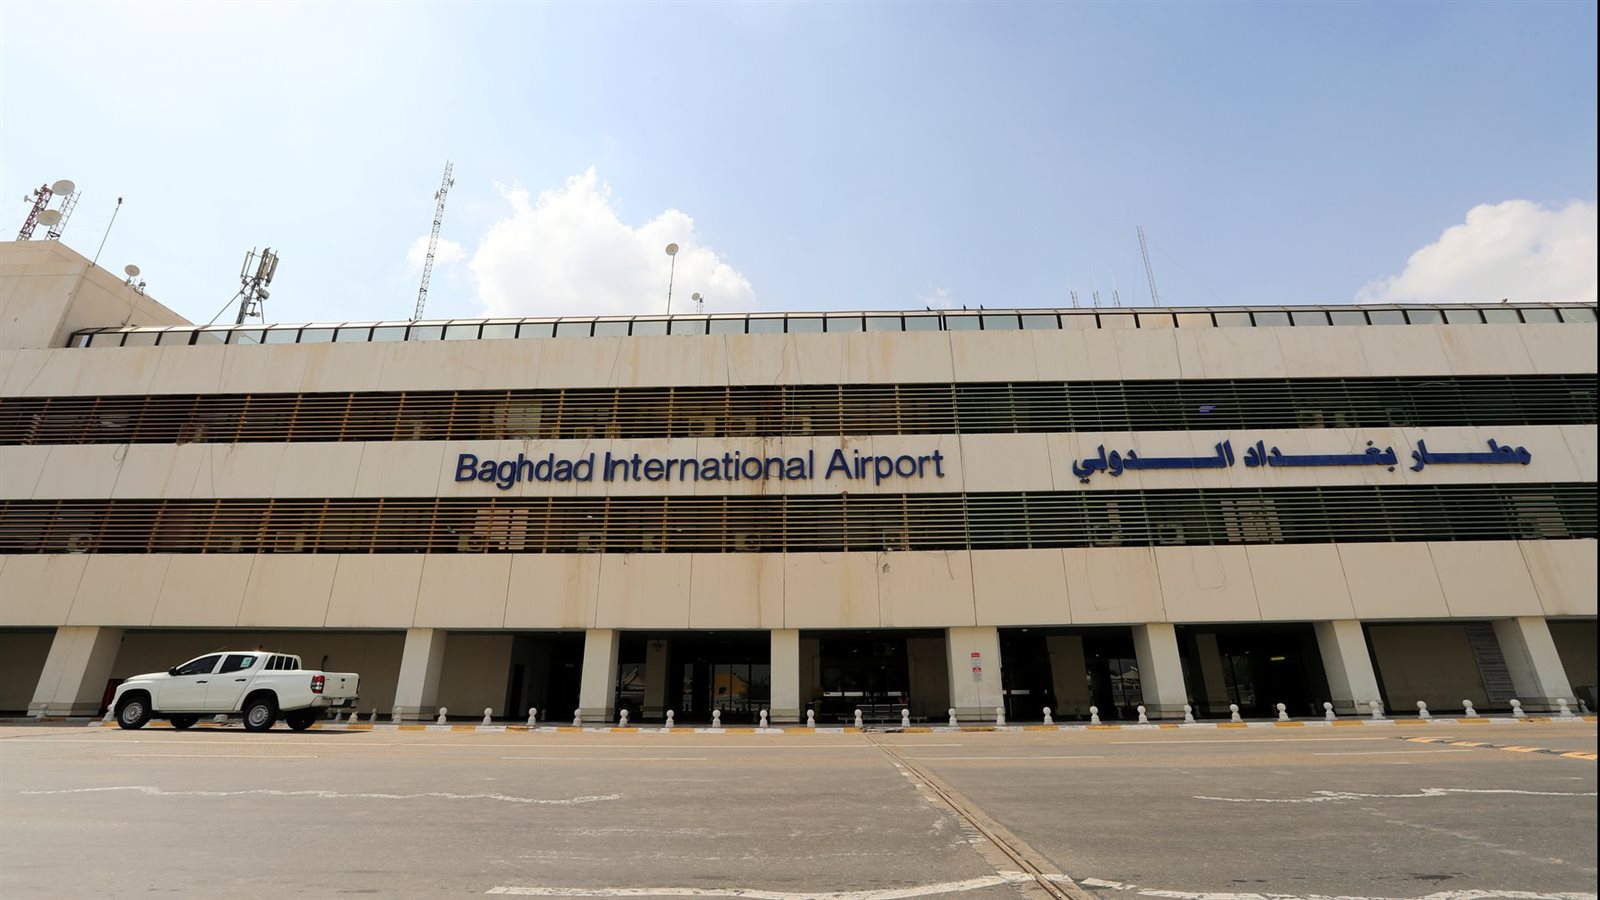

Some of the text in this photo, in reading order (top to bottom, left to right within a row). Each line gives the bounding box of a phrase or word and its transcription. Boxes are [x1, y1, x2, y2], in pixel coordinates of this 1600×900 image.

[455, 448, 944, 490] Baghdad International Airport
[1072, 438, 1532, 483] مطار بغداد الدولي
